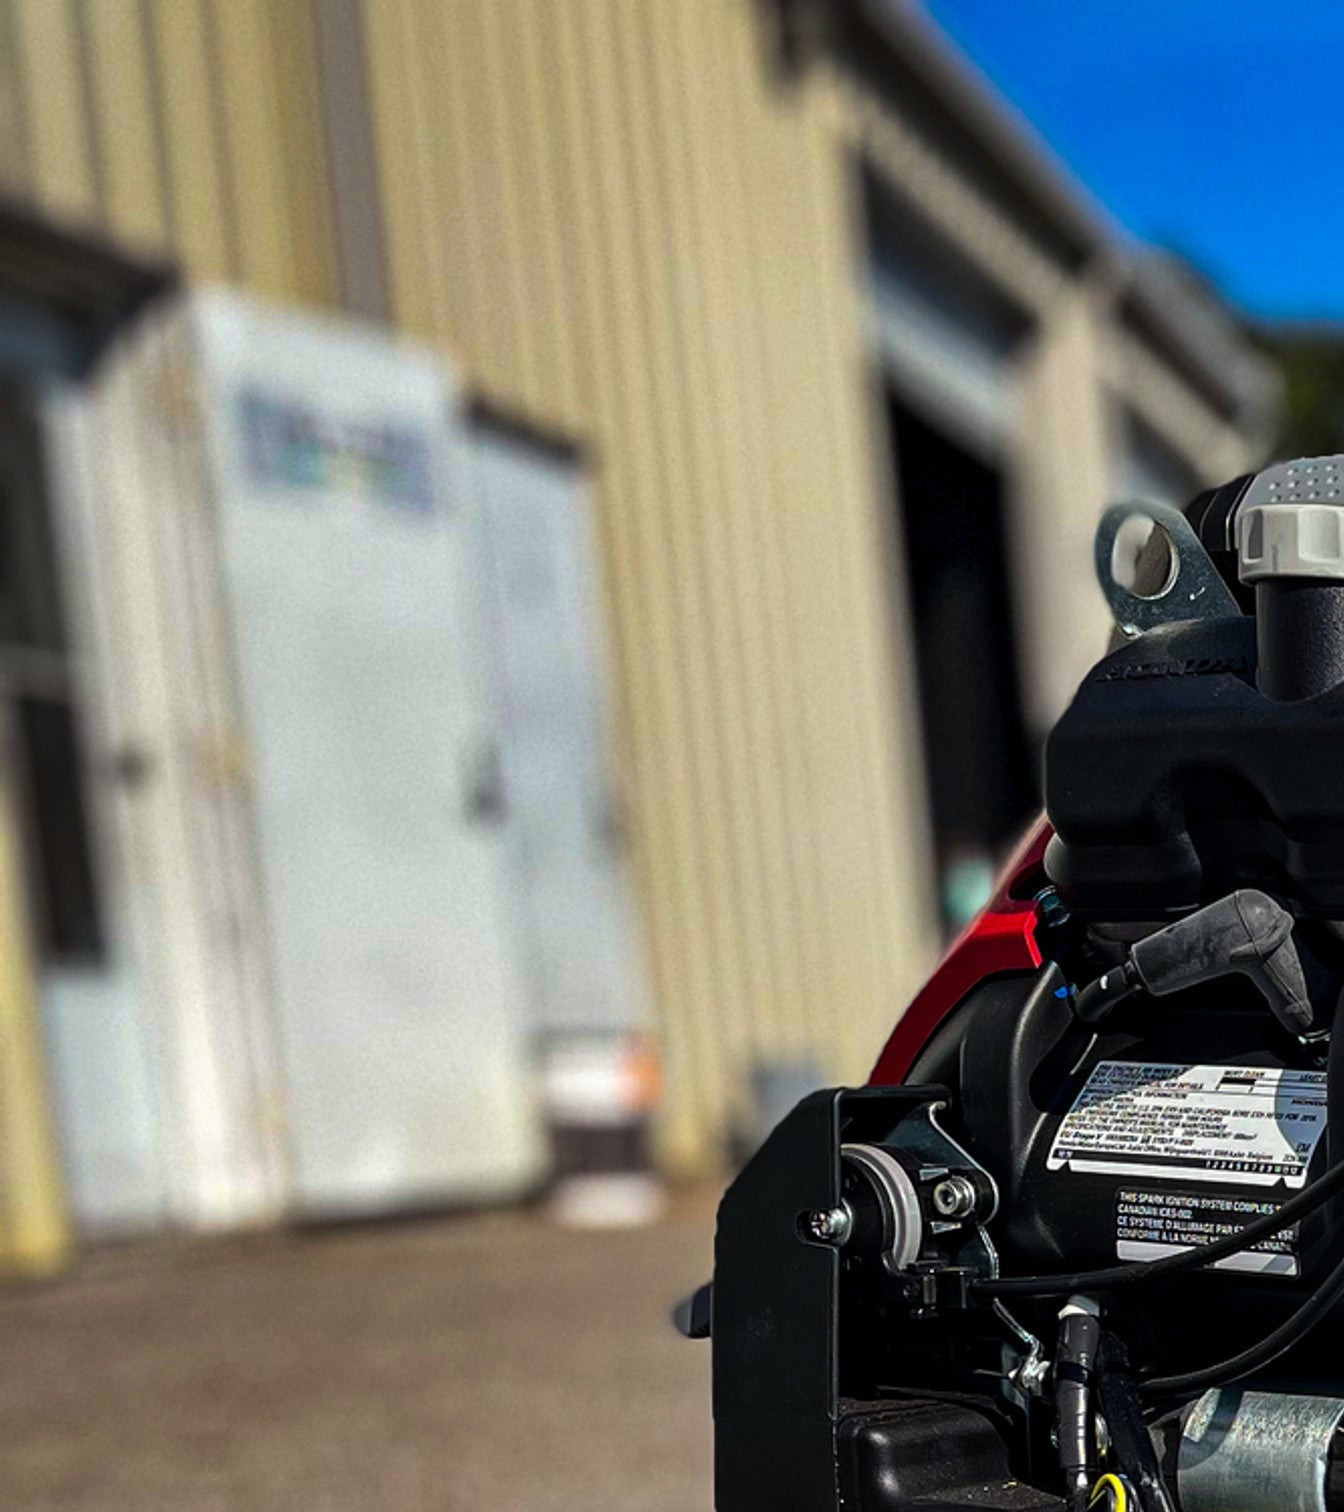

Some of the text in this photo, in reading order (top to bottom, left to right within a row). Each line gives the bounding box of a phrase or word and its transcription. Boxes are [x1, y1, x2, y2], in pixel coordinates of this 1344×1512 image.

[1117, 1203, 1158, 1216] CANADIAN
[1120, 1191, 1138, 1203] THIS
[1138, 1193, 1165, 1205] SPARK
[1165, 1195, 1199, 1208] IGNITION
[1199, 1197, 1233, 1211] SYSTEM
[1233, 1201, 1274, 1215] COMPLIES
[1117, 1215, 1129, 1227] CE
[1215, 1222, 1233, 1235] PAR
[1117, 1227, 1160, 1241] CONFORME
[1168, 1231, 1180, 1243] LA
[1180, 1233, 1209, 1246] NORME
